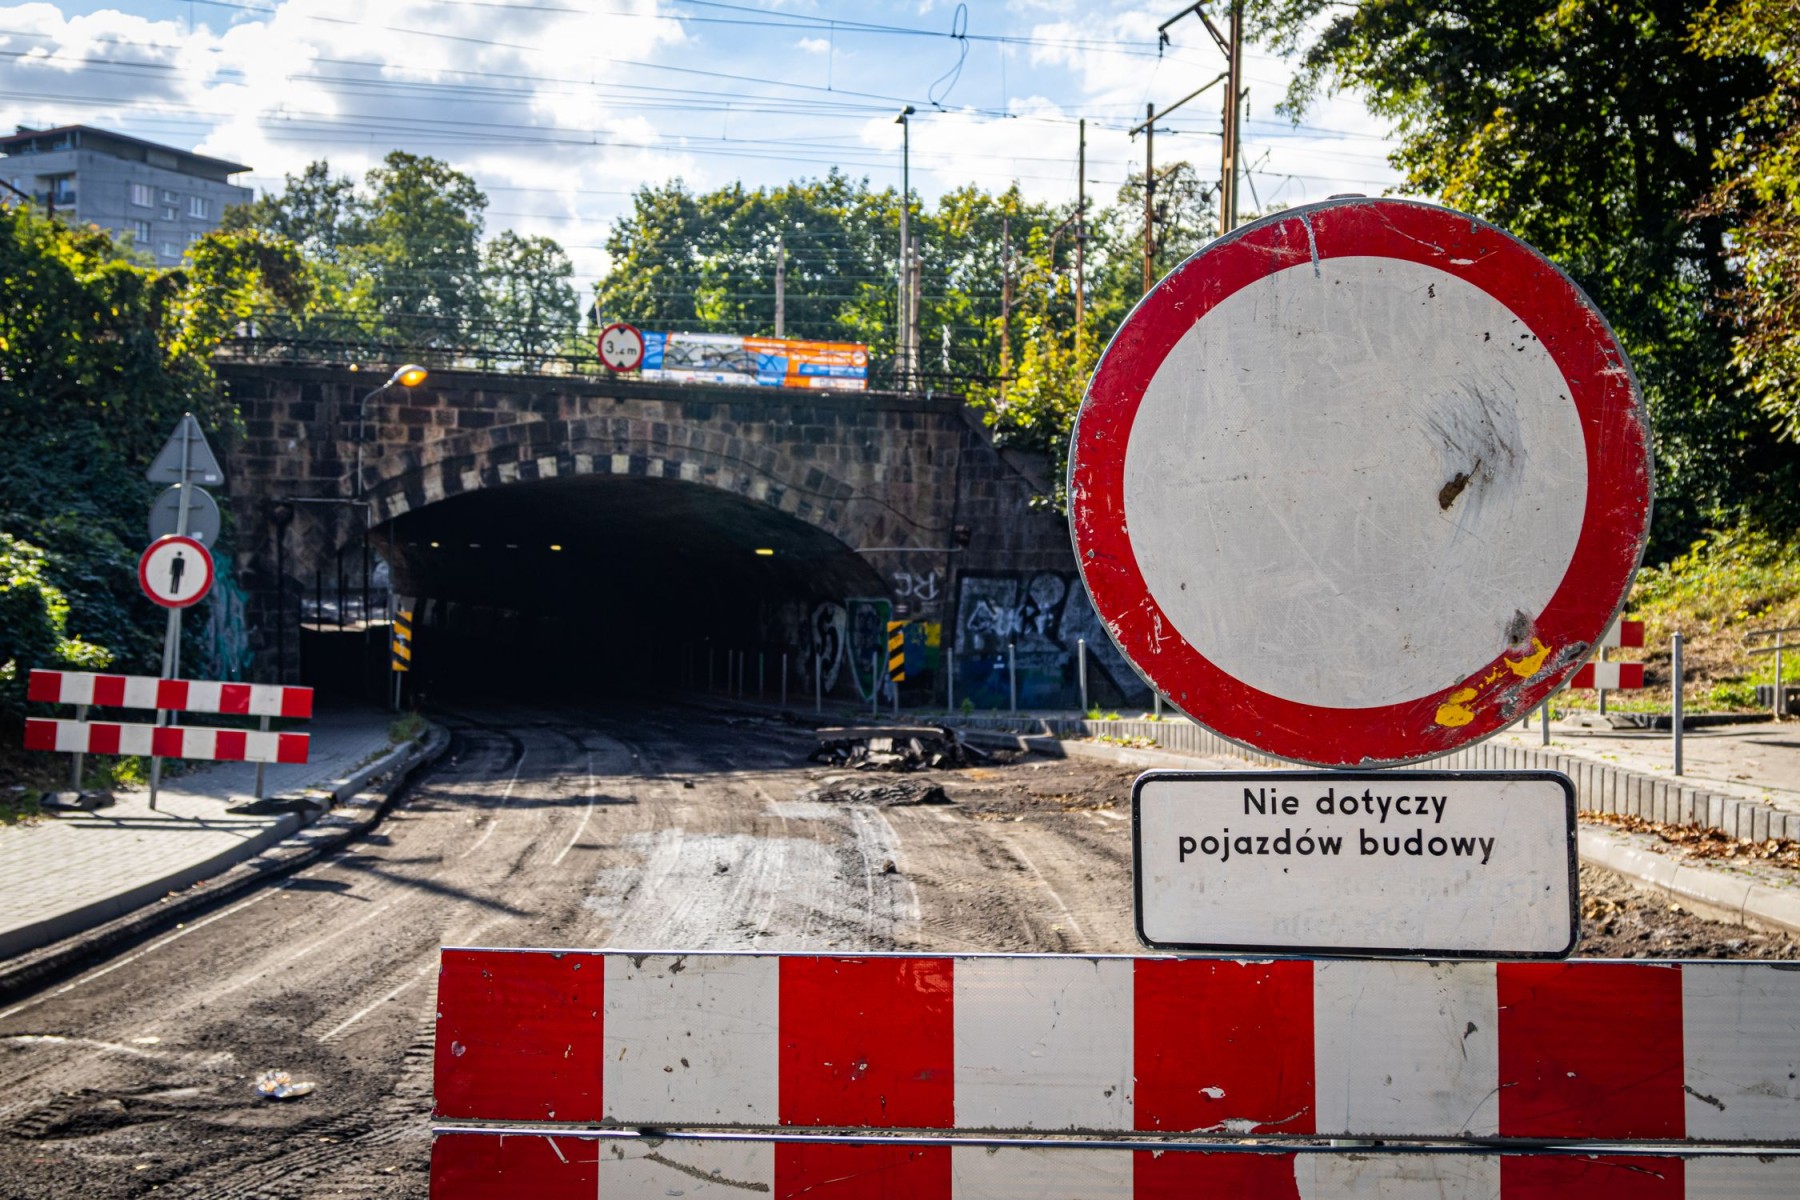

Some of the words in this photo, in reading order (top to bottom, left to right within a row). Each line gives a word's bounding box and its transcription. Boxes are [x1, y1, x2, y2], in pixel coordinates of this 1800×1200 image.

[1243, 787, 1299, 816] Nie
[1315, 787, 1448, 824] dotyczy
[1179, 827, 1343, 863] pojazdów
[1359, 828, 1495, 866] budowy
